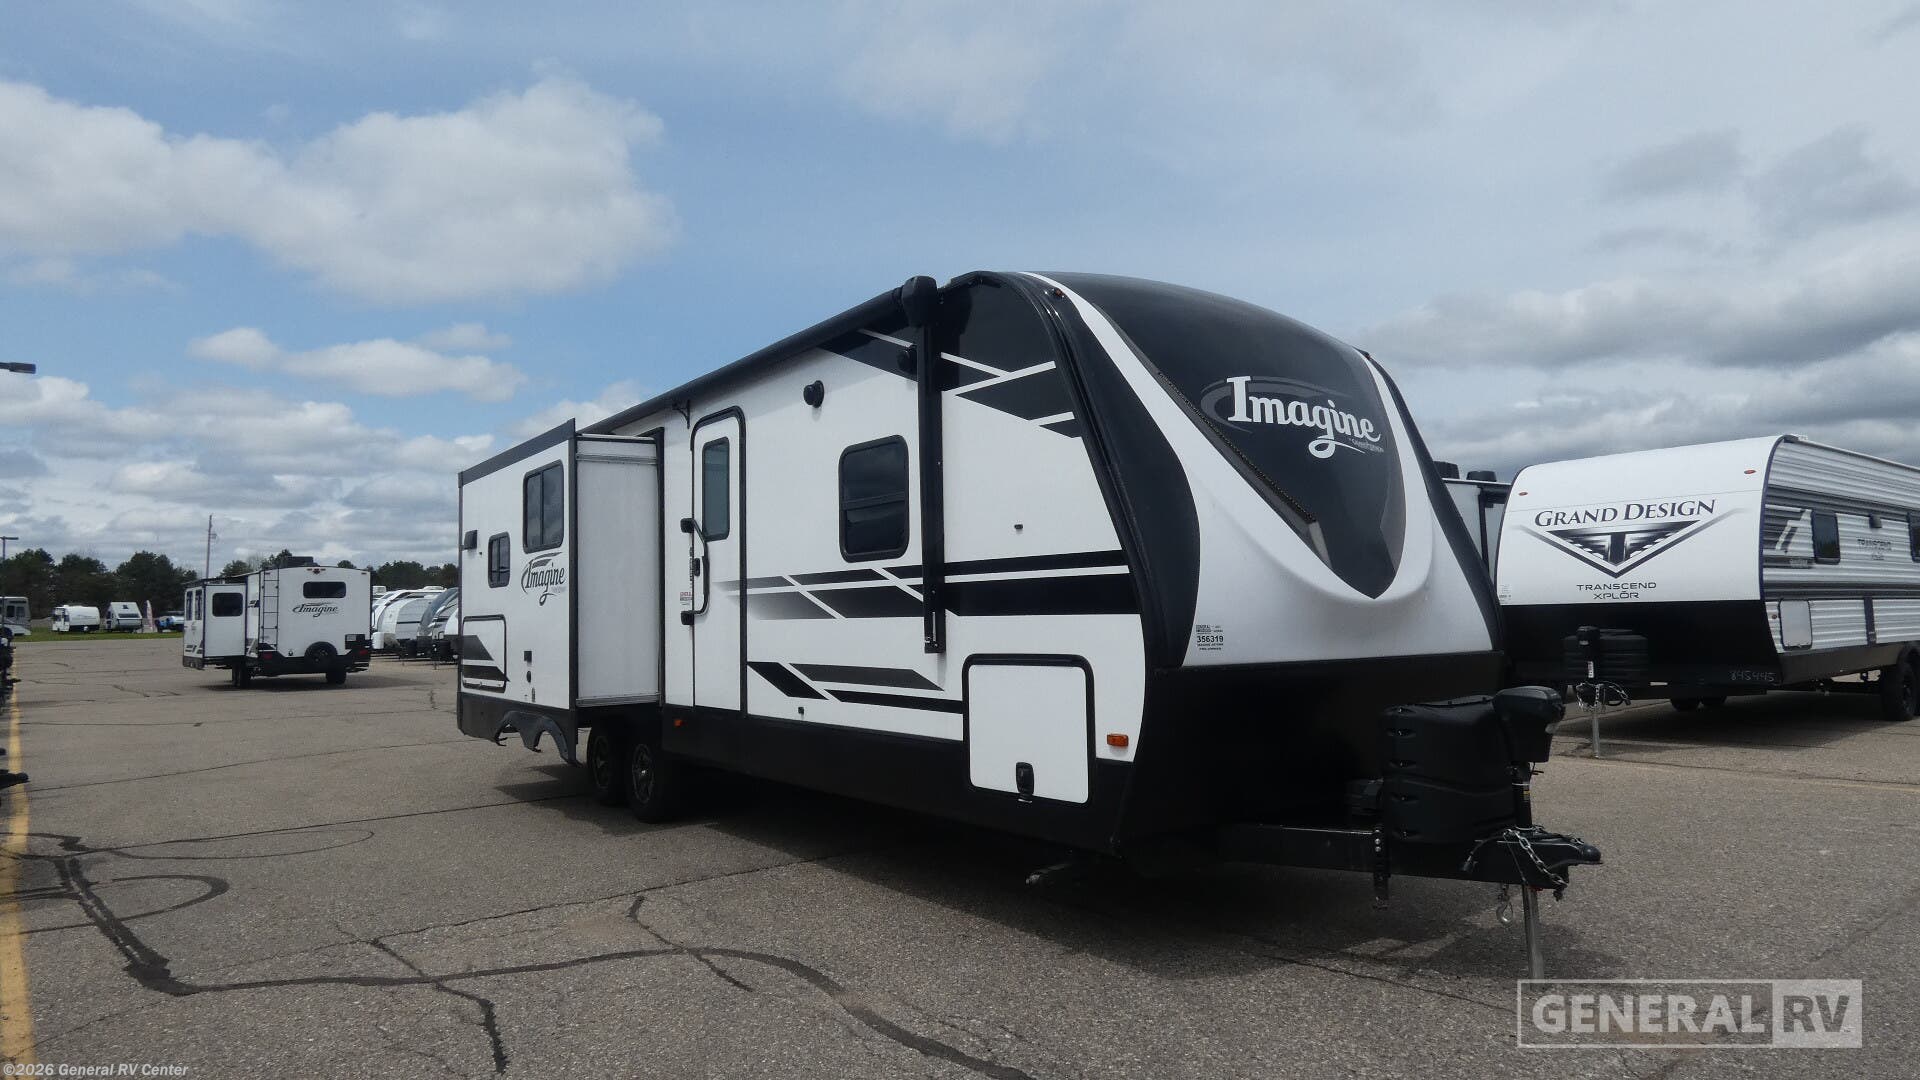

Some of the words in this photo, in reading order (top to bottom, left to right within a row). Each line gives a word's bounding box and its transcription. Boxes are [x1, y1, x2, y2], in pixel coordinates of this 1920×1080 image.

[1226, 376, 1381, 459] Imagine
[1535, 507, 1619, 527] GRAND
[1623, 499, 1716, 521] DESIGN
[524, 559, 566, 607] Imagine
[1576, 582, 1657, 591] TRANSCEND
[293, 603, 338, 617] Imagine
[1196, 635, 1224, 643] 356319
